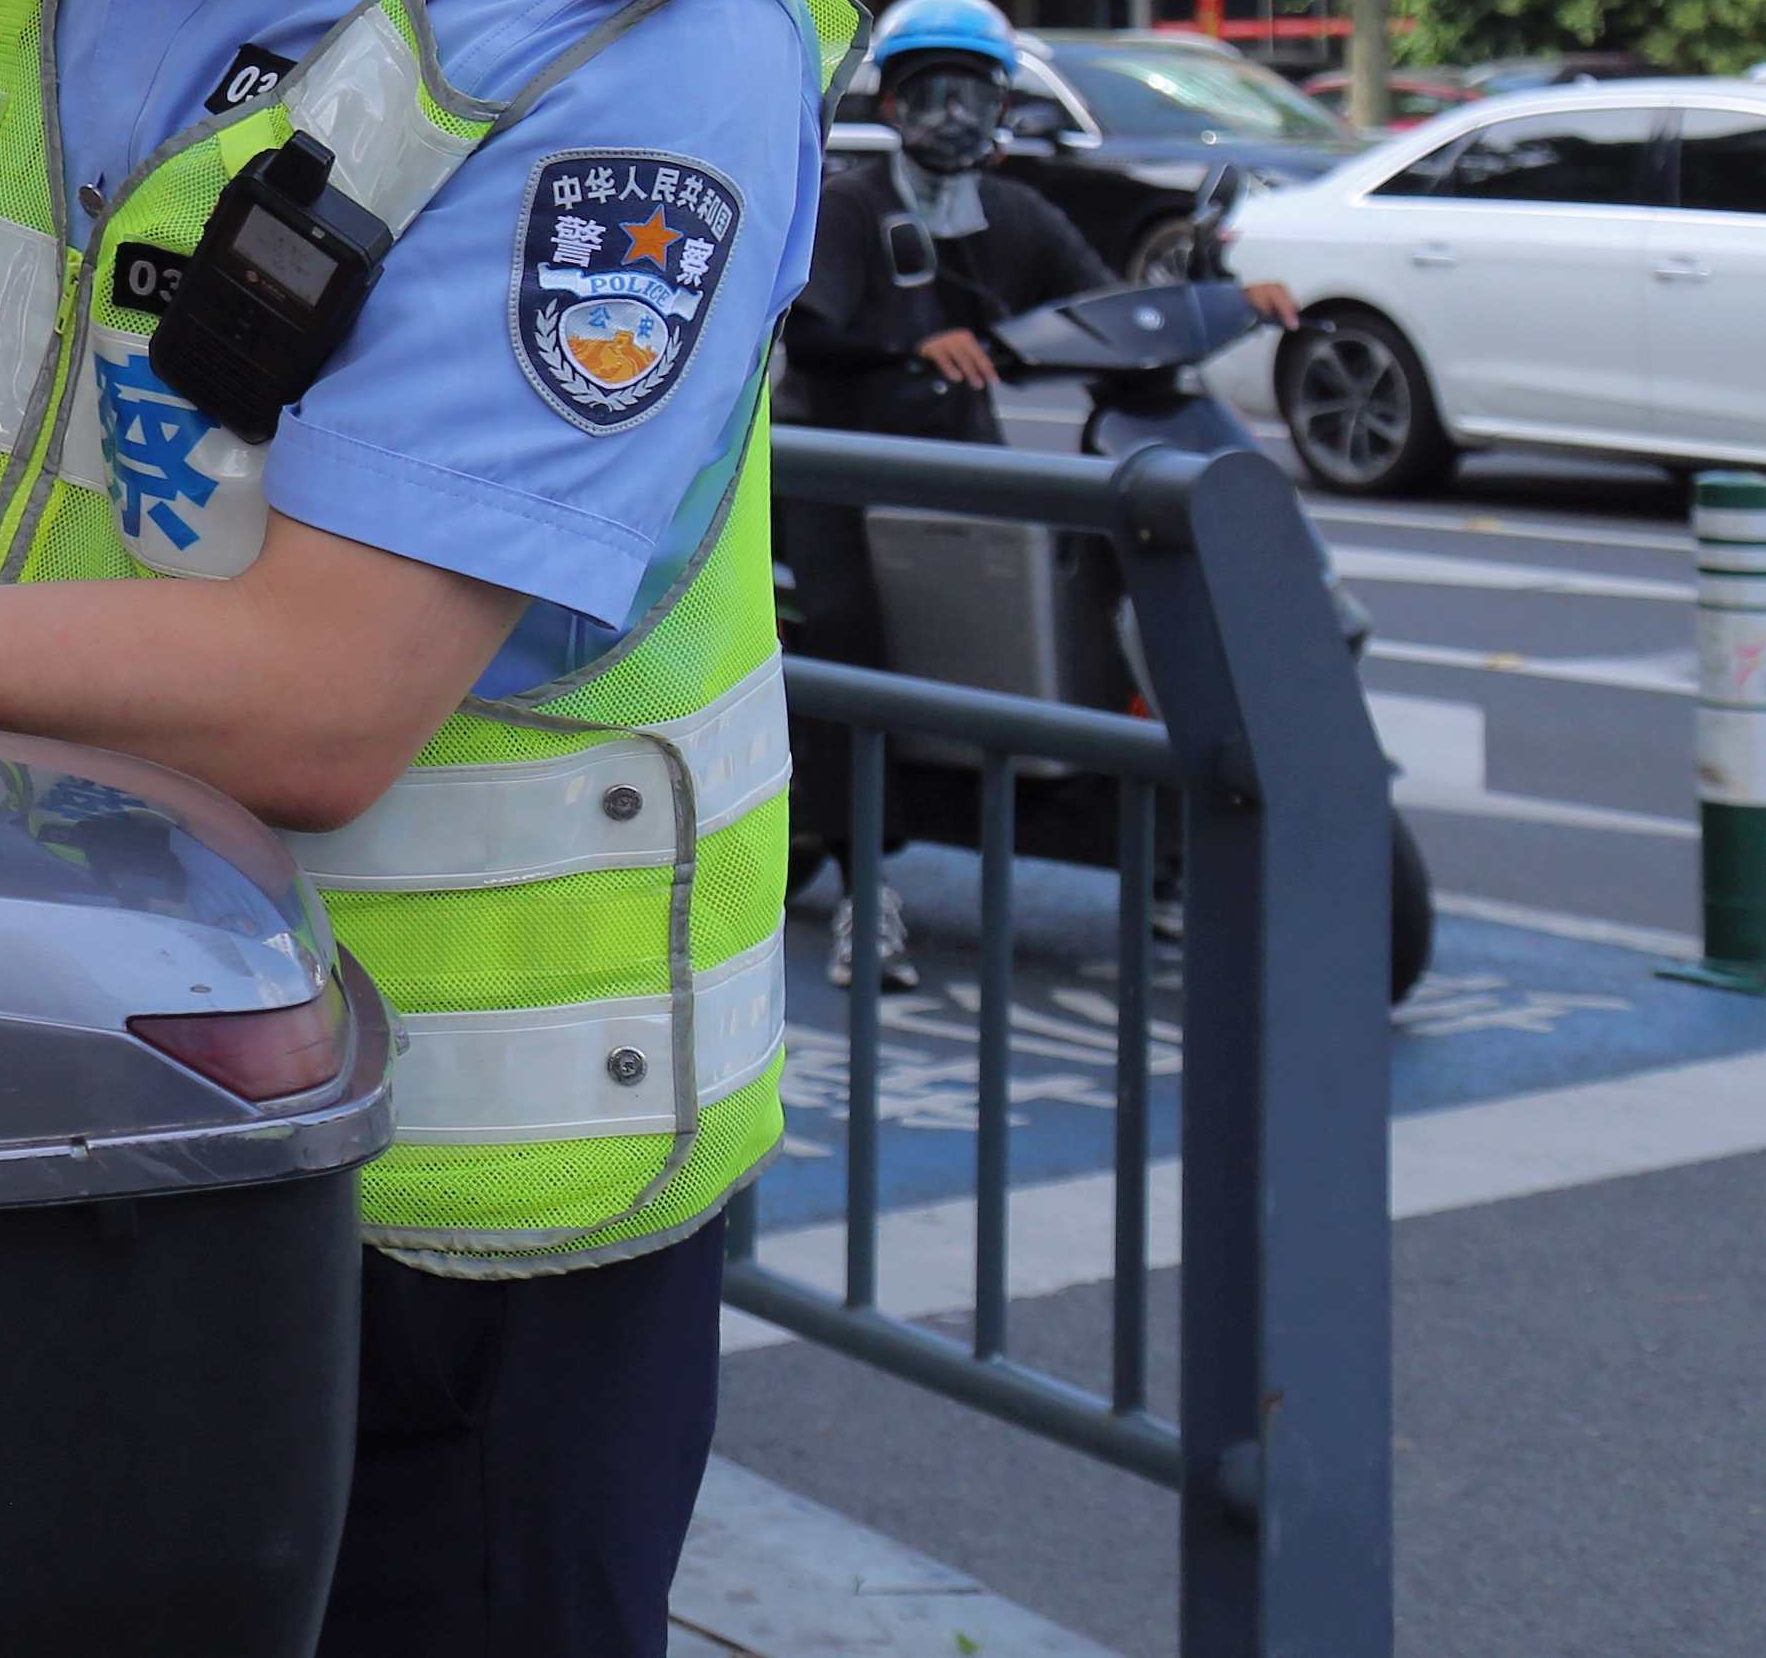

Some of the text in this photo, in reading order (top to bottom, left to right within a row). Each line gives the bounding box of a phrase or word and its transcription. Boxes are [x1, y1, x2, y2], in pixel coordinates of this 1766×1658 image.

[552, 164, 734, 242] 中华人民共和国
[588, 272, 671, 312] POLICE
[588, 306, 655, 340] 公安
